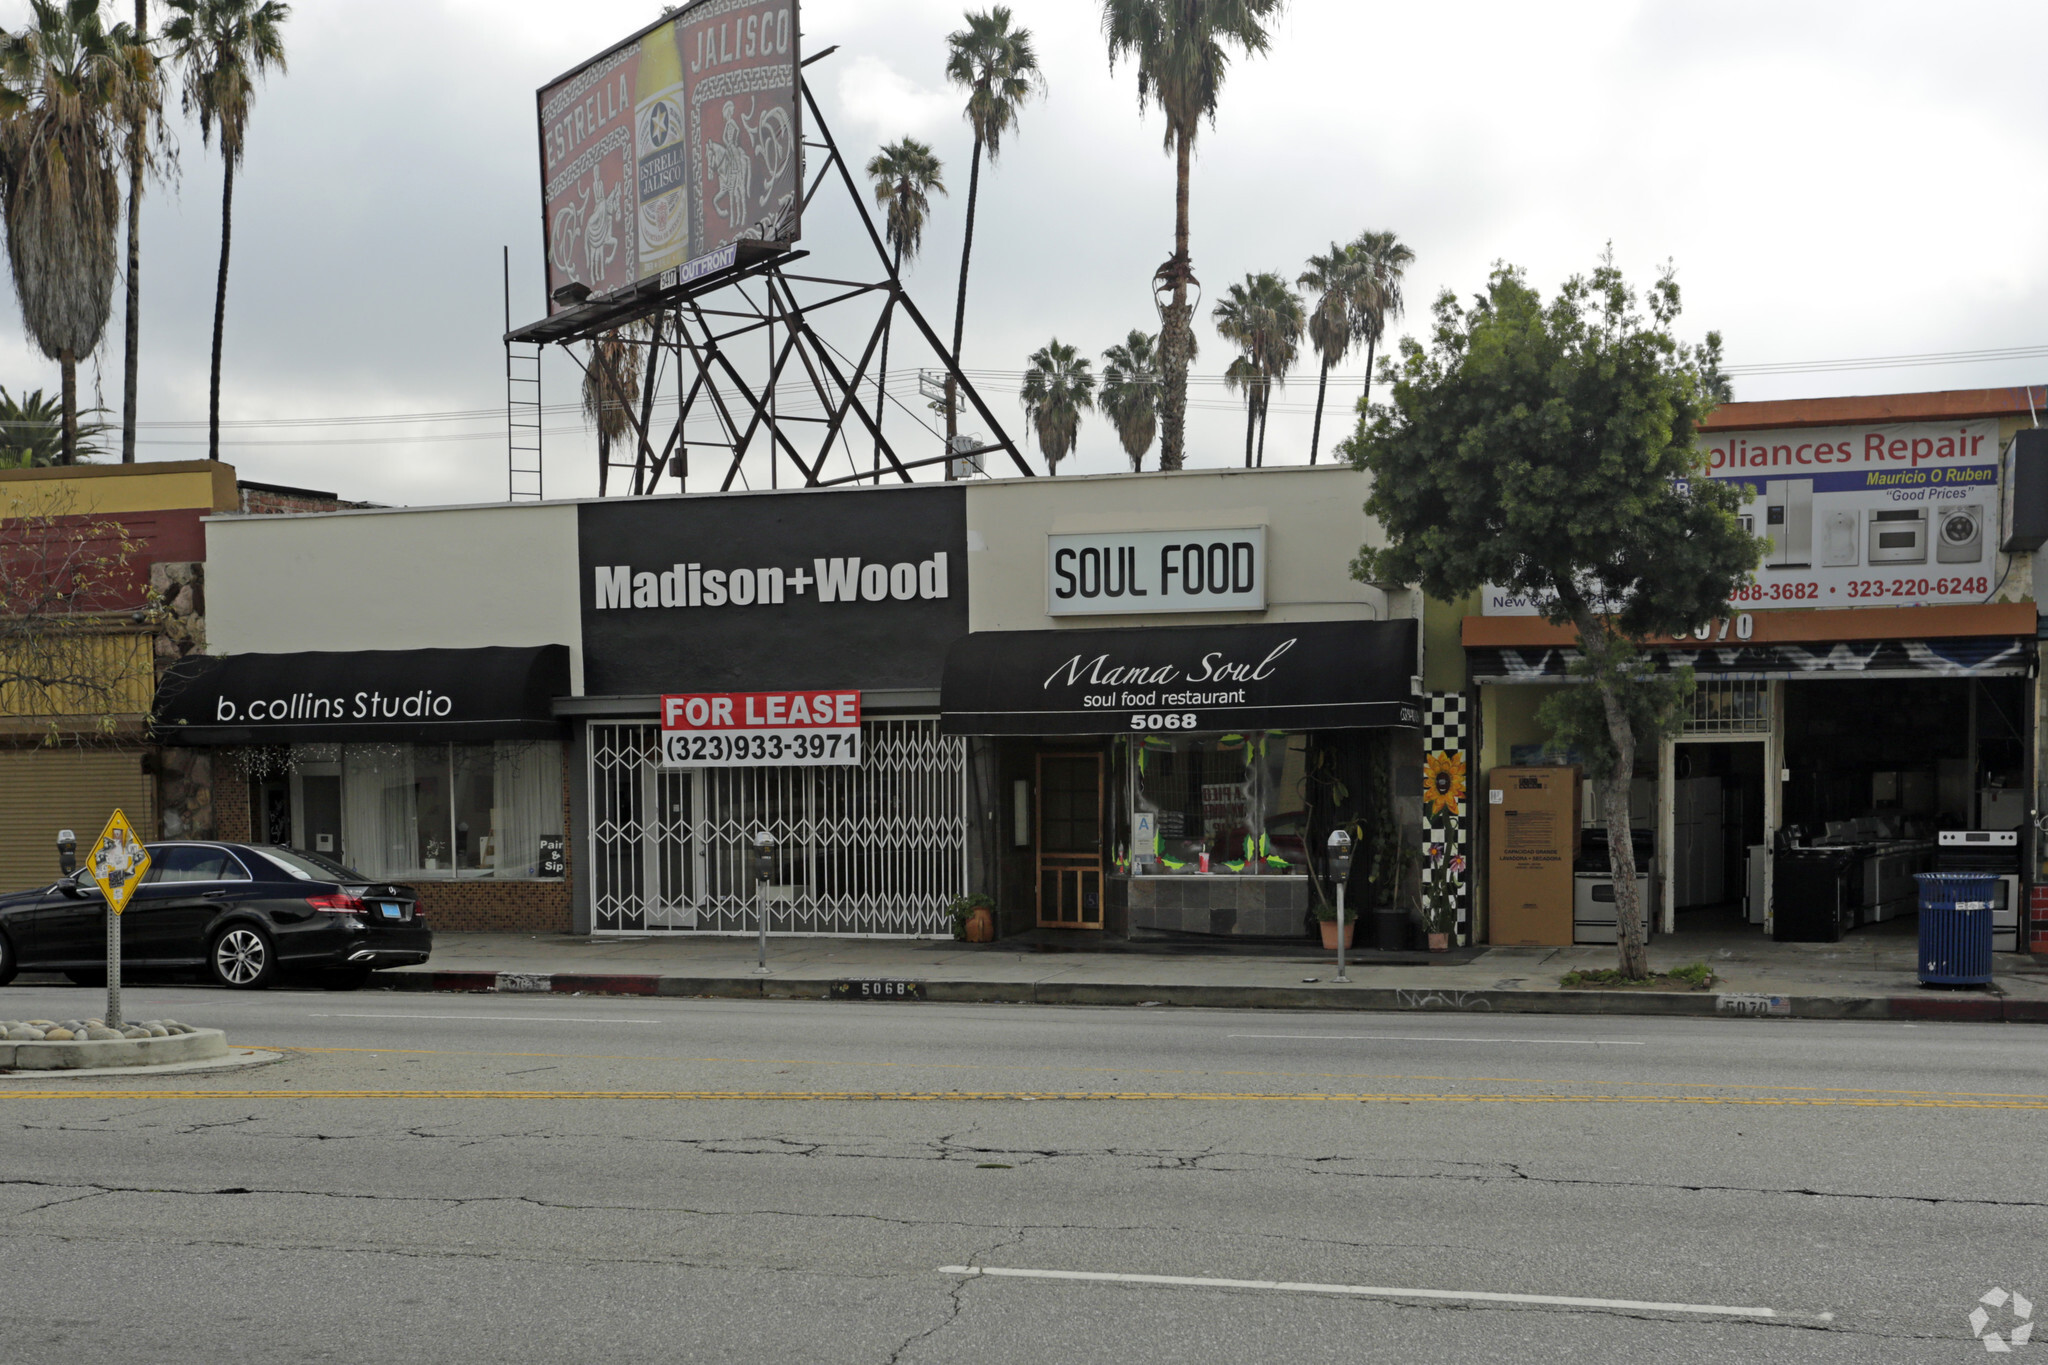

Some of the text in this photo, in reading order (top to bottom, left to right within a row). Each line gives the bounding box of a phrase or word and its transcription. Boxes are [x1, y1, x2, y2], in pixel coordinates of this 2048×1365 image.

[691, 8, 790, 73] JALISCO
[545, 72, 630, 171] ESTRELLA
[640, 147, 685, 181] ESTRELLA
[643, 164, 681, 195] JALISCO
[681, 247, 735, 281] OUTFRONT
[1686, 427, 1985, 477] pliances Repair
[1866, 467, 1992, 486] Mauricio O Ruben
[595, 551, 949, 609] Madison+Wood
[1055, 541, 1254, 599] SOUL FOOD
[1493, 596, 1527, 608] New
[1530, 594, 1542, 607] &
[1847, 577, 1988, 598] 323-220-6248
[1672, 613, 1754, 641] 070
[1043, 638, 1298, 690] Mama Soul
[216, 690, 453, 721] b.collins Studio
[665, 694, 857, 726] FOR LEASE
[1083, 688, 1246, 707] soul food restaurant
[1130, 713, 1198, 730] 5068
[666, 733, 858, 762] (323)933-3971
[1138, 817, 1150, 830] A
[545, 861, 564, 872] Sip
[551, 850, 561, 860] &
[862, 982, 905, 995] 5068
